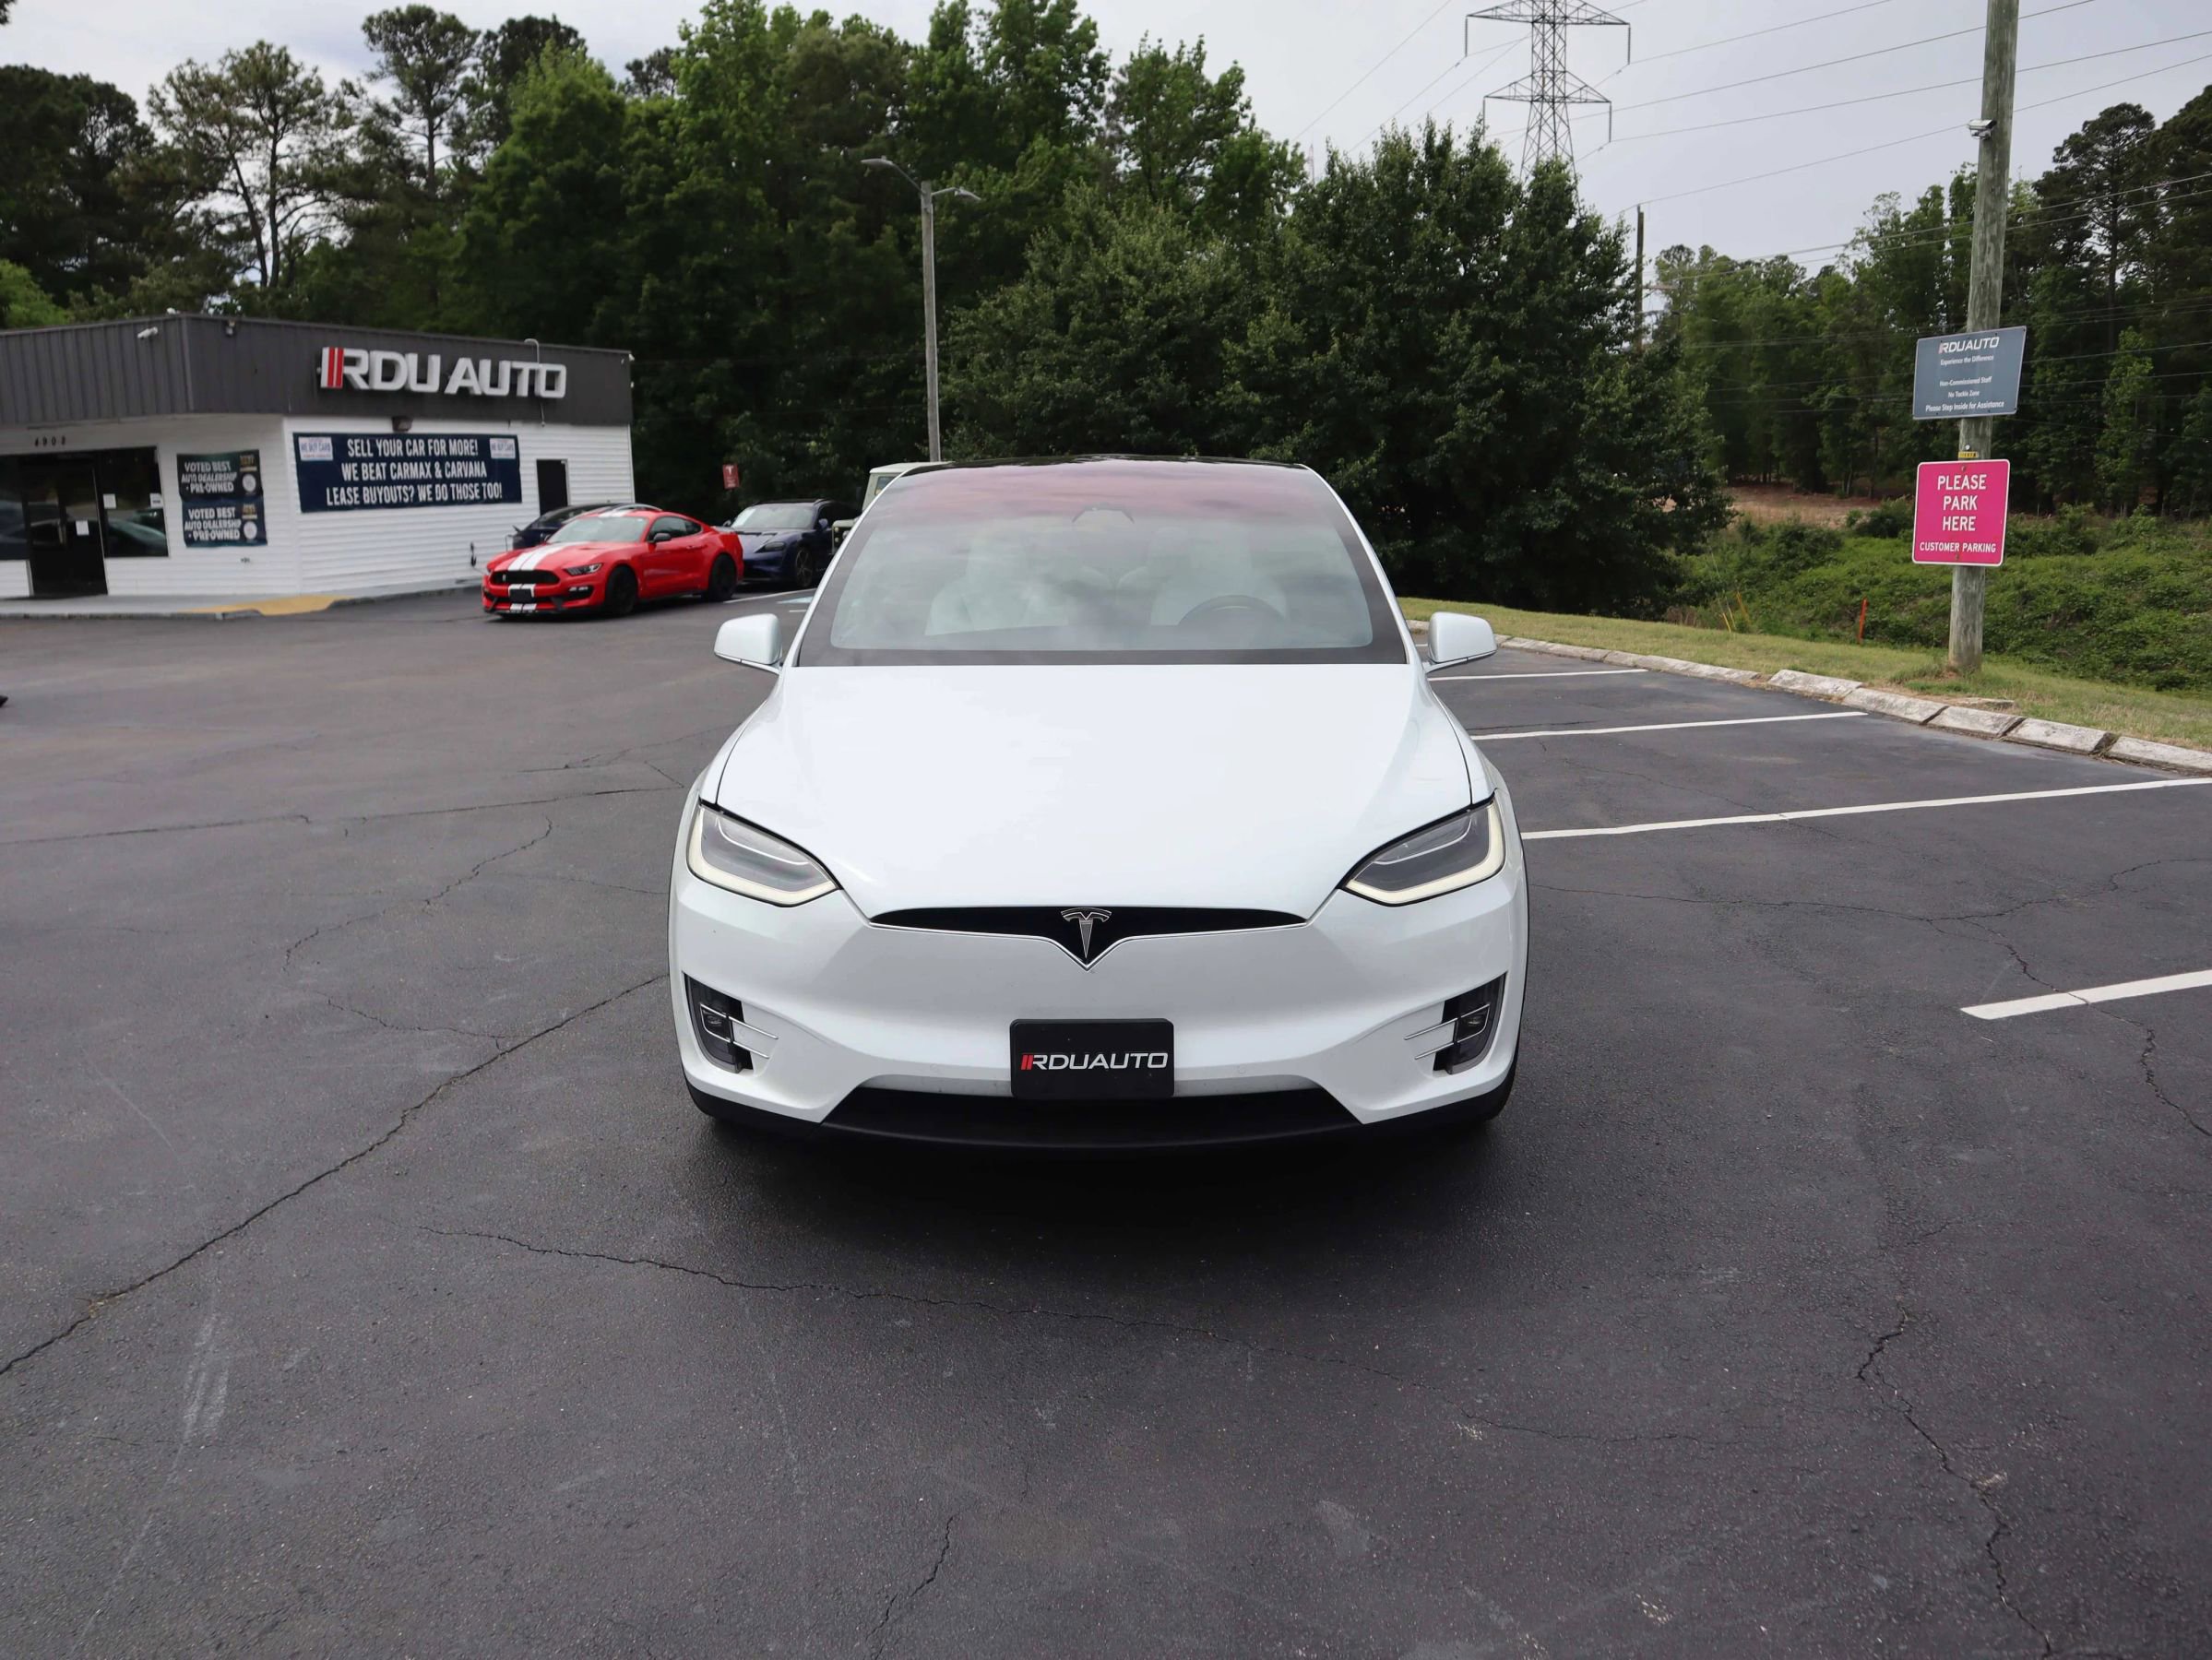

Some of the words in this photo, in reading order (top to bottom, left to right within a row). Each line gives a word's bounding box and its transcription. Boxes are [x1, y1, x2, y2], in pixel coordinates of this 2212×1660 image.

[1940, 356, 1963, 366] Experience
[1971, 354, 1994, 362] Difference
[445, 357, 567, 398] AUTO
[1980, 375, 1992, 385] Staff
[1925, 404, 1942, 412] Please
[1942, 403, 1954, 413] Step
[1954, 402, 1968, 410] Inside
[1977, 400, 2004, 409] Assistance
[347, 439, 374, 458] SELL
[375, 438, 404, 457] YOUR
[406, 439, 425, 457] CAR
[427, 439, 446, 456] FOR
[449, 438, 479, 456] MORE!
[184, 461, 212, 472] VOTED
[212, 461, 232, 472] BEST
[341, 463, 359, 481] WE
[361, 462, 387, 480] BEAT
[389, 461, 433, 480] CARMAX
[434, 461, 443, 479] &
[445, 460, 488, 479] CARVANA
[182, 473, 197, 484] AUTO
[197, 472, 237, 482] DEALERSHIP
[1937, 473, 1988, 491] PLEASE
[190, 482, 234, 493] PRE-OWNED
[327, 486, 361, 506] LEASE
[363, 484, 415, 504] BUYOUTS?
[417, 484, 434, 503] WE
[435, 483, 449, 501] DO
[450, 482, 481, 500] THOSE
[482, 481, 503, 499] TOO!
[1943, 494, 1979, 511] PARK
[188, 507, 216, 519] VOTED
[216, 507, 235, 518] BEST
[184, 520, 202, 531] AUTO
[202, 518, 242, 530] DEALERSHIP
[1942, 516, 1977, 532] HERE
[192, 529, 240, 540] PRE-OWNED
[1920, 541, 1960, 552] CUSTOMER
[1962, 542, 1996, 553] PARKING
